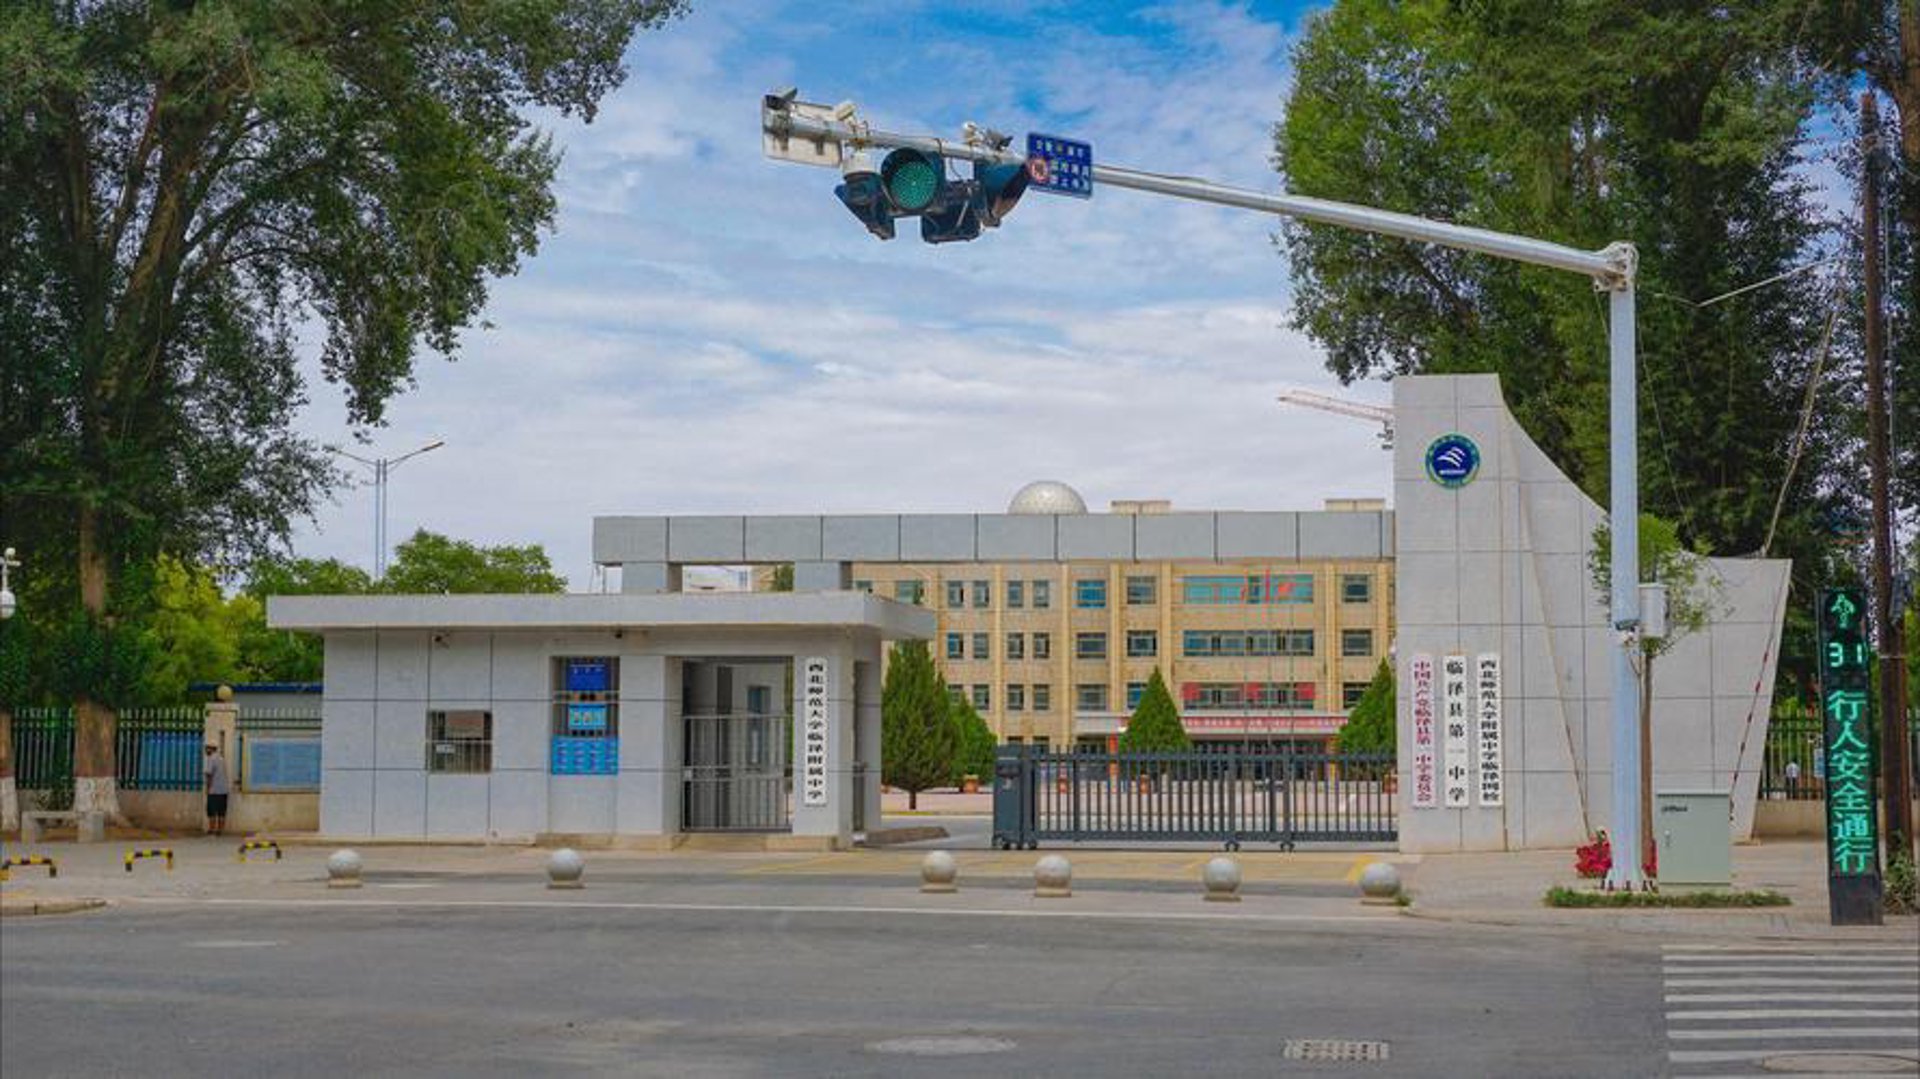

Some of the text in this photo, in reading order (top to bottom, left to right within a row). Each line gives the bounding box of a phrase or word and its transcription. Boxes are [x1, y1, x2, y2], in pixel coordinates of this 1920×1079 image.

[1828, 643, 1863, 668] 31
[1446, 660, 1465, 802] 临泽县第一中学
[1827, 689, 1873, 874] 行人安全通行
